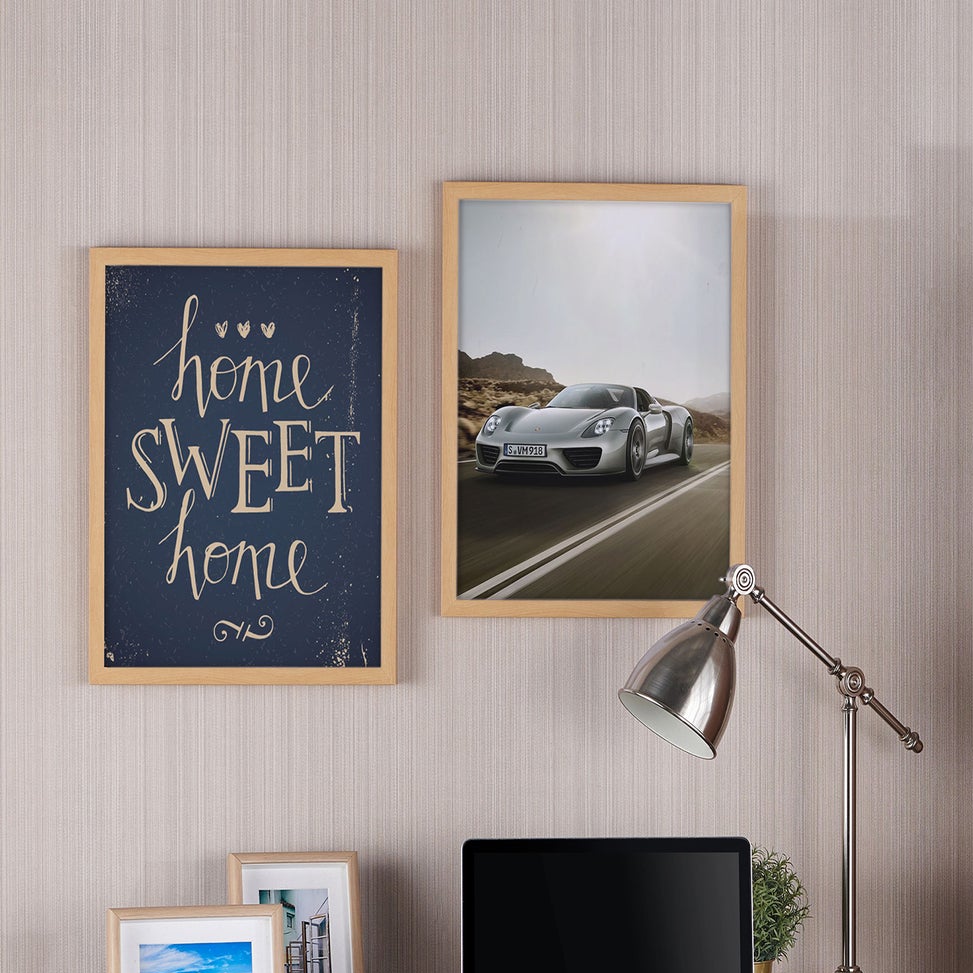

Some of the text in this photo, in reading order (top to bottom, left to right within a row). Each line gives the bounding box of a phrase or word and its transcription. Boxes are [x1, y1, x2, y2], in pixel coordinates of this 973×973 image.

[154, 294, 334, 417] home
[126, 418, 361, 514] SWEET
[159, 489, 328, 600] home
